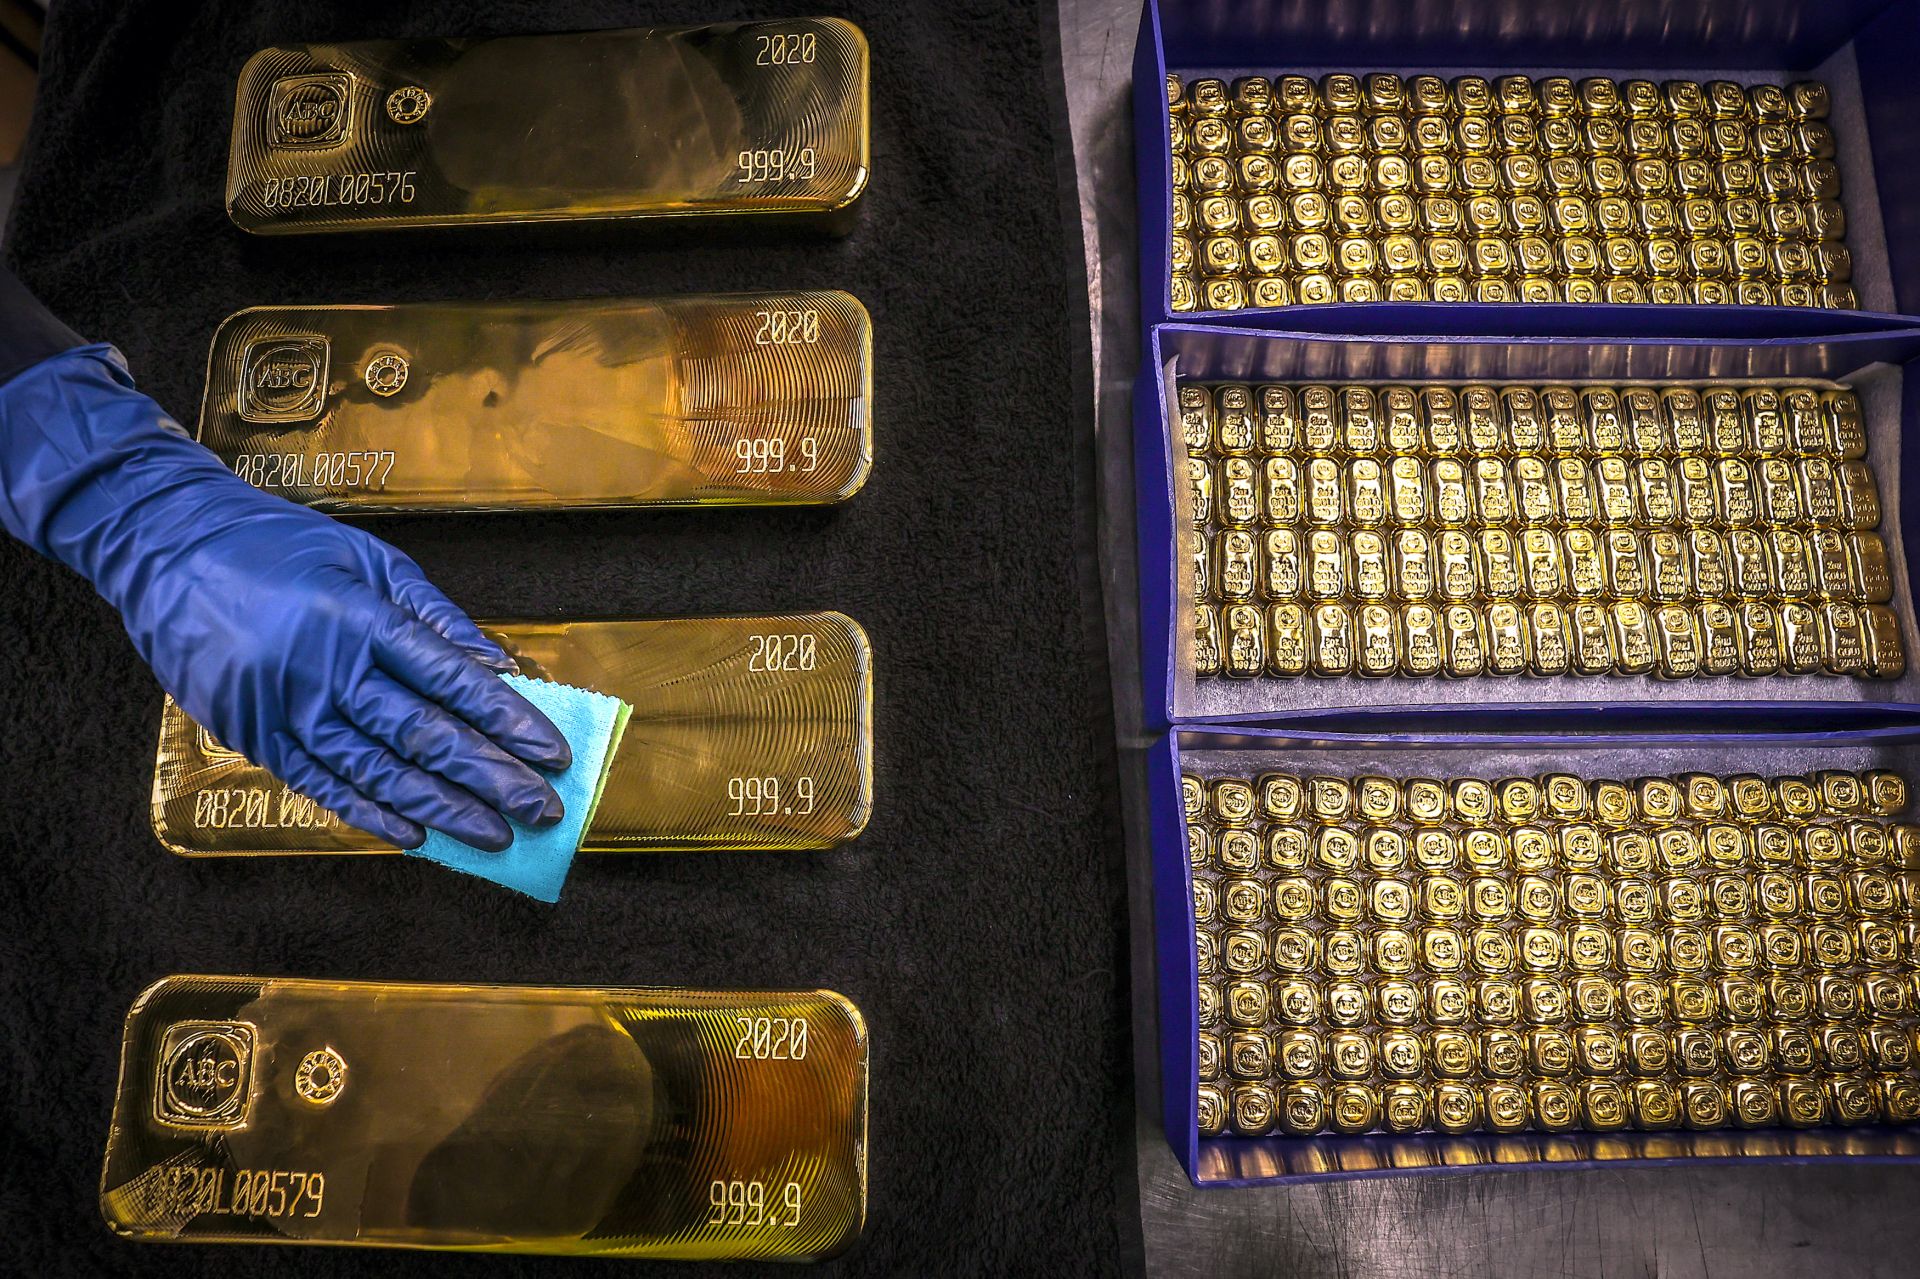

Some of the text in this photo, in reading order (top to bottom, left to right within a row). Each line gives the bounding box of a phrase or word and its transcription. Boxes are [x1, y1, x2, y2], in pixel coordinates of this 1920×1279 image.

[757, 33, 816, 65] 2020
[739, 148, 815, 182] 999.9
[265, 172, 416, 207] 0820L00576
[756, 310, 819, 344] 2020
[257, 367, 310, 388] ABC
[235, 451, 396, 487] 0820L00577
[736, 437, 818, 473] 999.9
[749, 634, 816, 672] 2020
[728, 776, 814, 816] 999.9
[736, 1017, 807, 1060] 2020
[175, 1058, 236, 1088] ABC
[709, 1181, 801, 1226] 999.9
